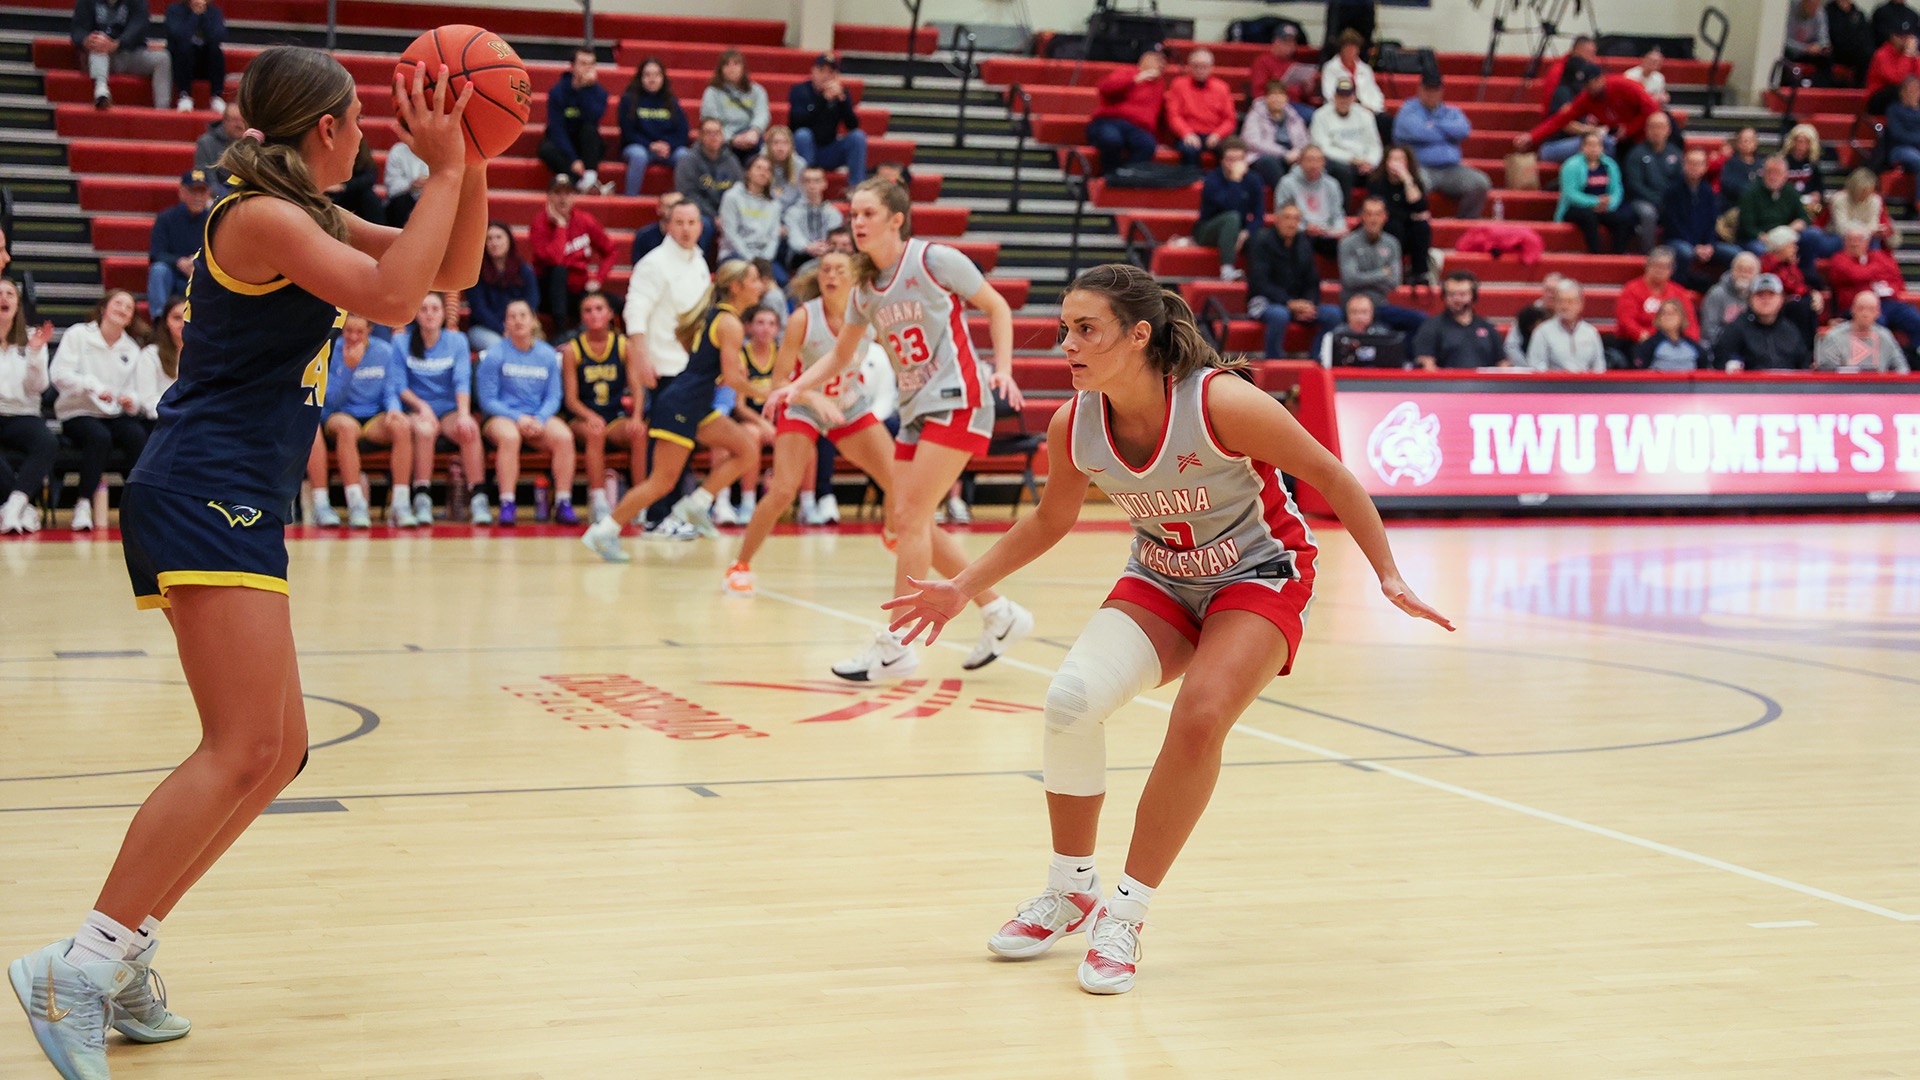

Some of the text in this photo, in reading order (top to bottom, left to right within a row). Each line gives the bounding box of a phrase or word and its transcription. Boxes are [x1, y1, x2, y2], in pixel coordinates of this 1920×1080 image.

[1469, 413, 1599, 474] IWU
[1605, 413, 1886, 474] WOMEN'S
[1110, 486, 1211, 519] INDIANA
[1139, 536, 1241, 578] WESLEYAN
